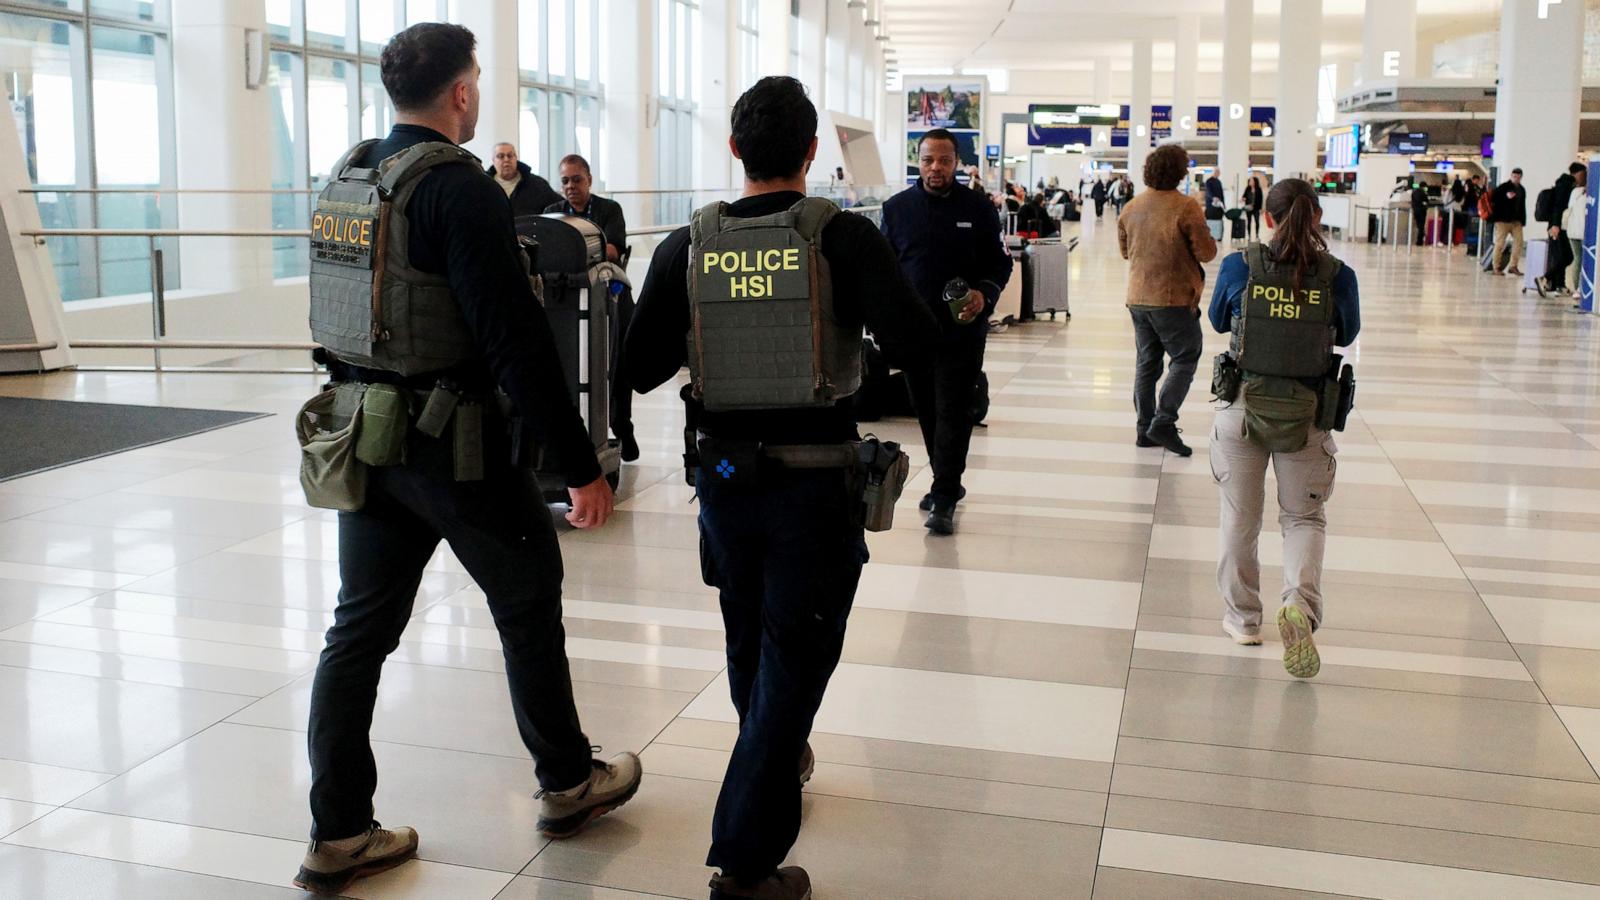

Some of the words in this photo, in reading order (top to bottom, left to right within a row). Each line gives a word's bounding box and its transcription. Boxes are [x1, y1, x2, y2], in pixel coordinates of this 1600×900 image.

[1383, 50, 1401, 76] E
[1229, 103, 1244, 120] D
[1136, 124, 1146, 137] B
[1180, 115, 1192, 130] C
[312, 214, 372, 246] POLICE
[703, 248, 800, 274] POLICE
[730, 275, 773, 298] HSI
[1269, 303, 1301, 319] HSI
